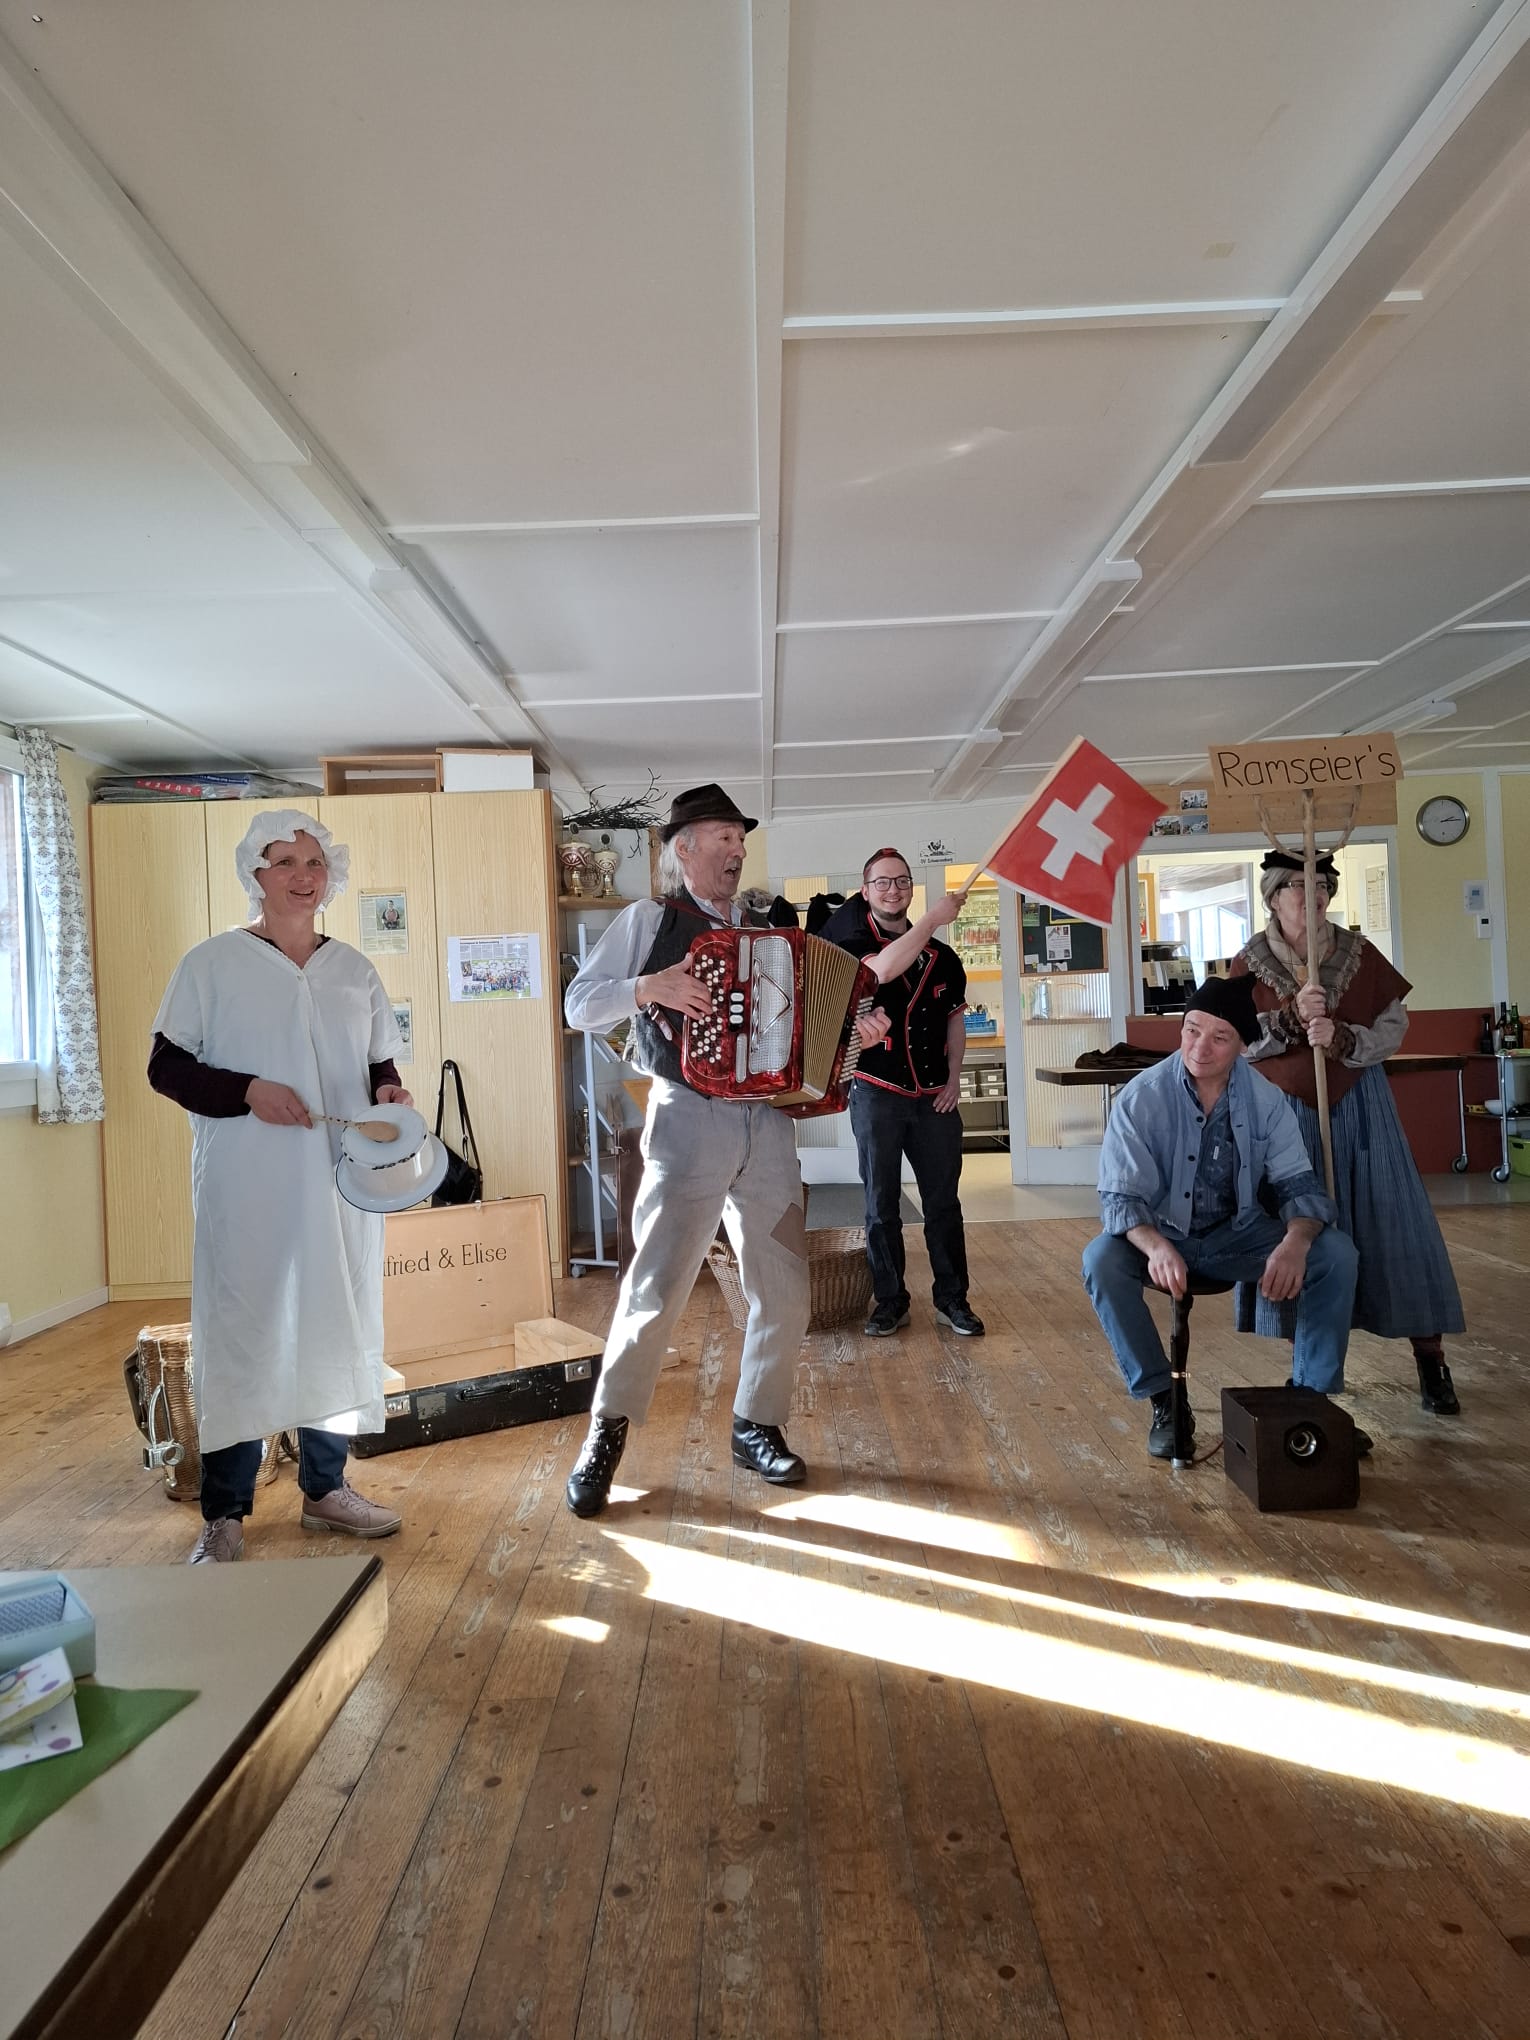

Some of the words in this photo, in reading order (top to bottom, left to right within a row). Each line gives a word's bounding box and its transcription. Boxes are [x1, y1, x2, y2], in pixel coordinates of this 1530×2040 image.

[1217, 744, 1396, 787] Ramseier's
[438, 1247, 455, 1269] &
[461, 1242, 507, 1266] Elise
